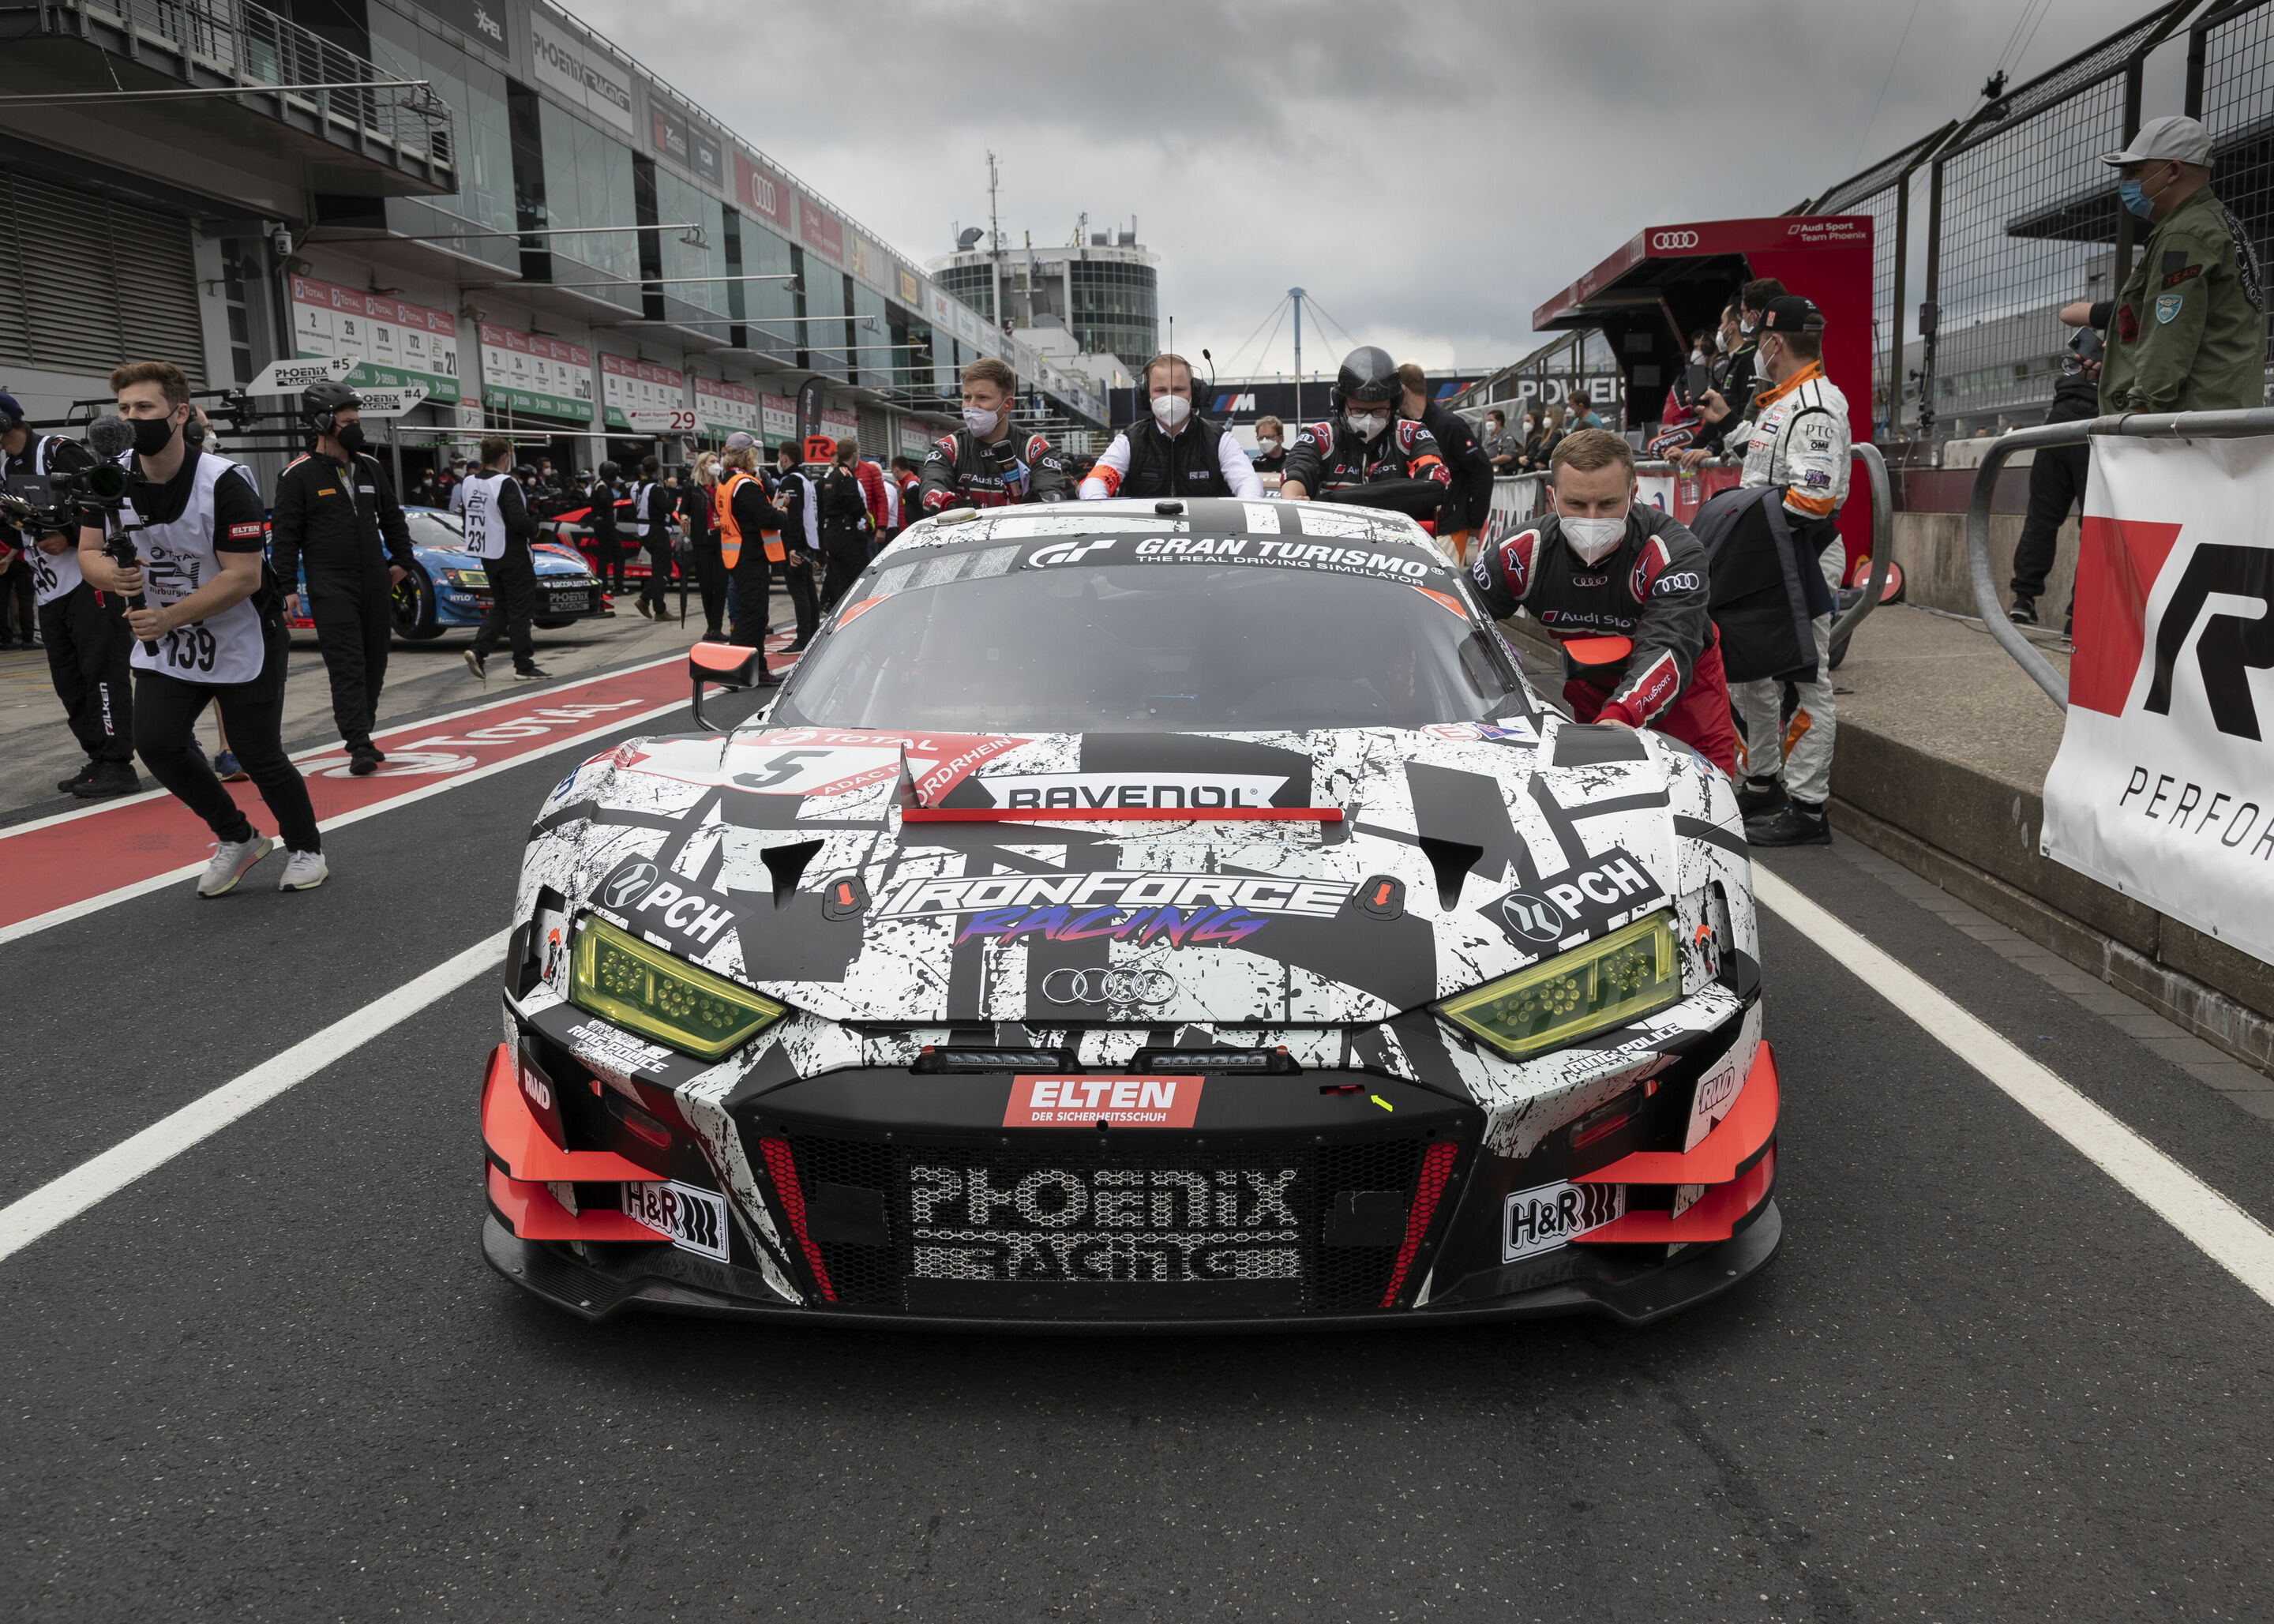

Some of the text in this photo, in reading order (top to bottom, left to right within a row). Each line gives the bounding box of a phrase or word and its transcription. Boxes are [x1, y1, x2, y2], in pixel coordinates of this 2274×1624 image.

[1826, 222, 1854, 232] Sport
[1829, 231, 1867, 241] Phoenix
[2167, 265, 2201, 285] YEAH
[304, 285, 325, 300] TOTAL
[340, 294, 361, 308] TOTAL
[373, 302, 393, 316] TOTAL
[405, 310, 424, 323] TOTAL
[310, 313, 317, 328] 2
[344, 320, 355, 336] 29
[434, 317, 452, 330] TOTAL
[377, 327, 389, 343] 170
[409, 335, 420, 349] 172
[275, 366, 329, 378] PHOENIX
[332, 358, 350, 370] #5
[445, 351, 458, 376] 21
[362, 395, 400, 403] OENIX
[404, 388, 422, 399] #4
[670, 411, 696, 429] 29
[1807, 424, 1833, 439] PTC
[971, 474, 993, 485] Audi
[232, 525, 260, 534] ELTEN
[469, 515, 486, 527] TV
[467, 530, 486, 553] 231
[1135, 538, 1428, 578] GRAN TURISMO
[1233, 557, 1311, 568] DRIVING
[1316, 563, 1424, 587] SIMULATOR
[1562, 612, 1638, 628] Audi Sor
[165, 628, 216, 672] 139
[1652, 674, 1672, 696] Sport
[99, 682, 114, 737] FALKEN
[392, 699, 644, 751] TOTAL
[824, 733, 940, 752] TOTAL
[732, 750, 835, 789] 5
[824, 770, 884, 795] ADAC
[879, 871, 1357, 917] IRONFORCE
[1544, 858, 1649, 921] PCH
[636, 882, 734, 943] PCH
[953, 905, 1270, 948] RACING
[566, 1025, 670, 1074] RING POLICE
[1565, 1022, 1685, 1075] RING POLICE
[524, 1067, 550, 1110] RWD
[1030, 1081, 1176, 1108] ELTEN
[1699, 1067, 1735, 1115] RWD
[1031, 1112, 1167, 1123] DER SICHERHEITSSCHUH
[911, 1165, 1299, 1227] PHOENIX
[626, 1181, 680, 1232] H&R
[1510, 1190, 1578, 1246] H&R
